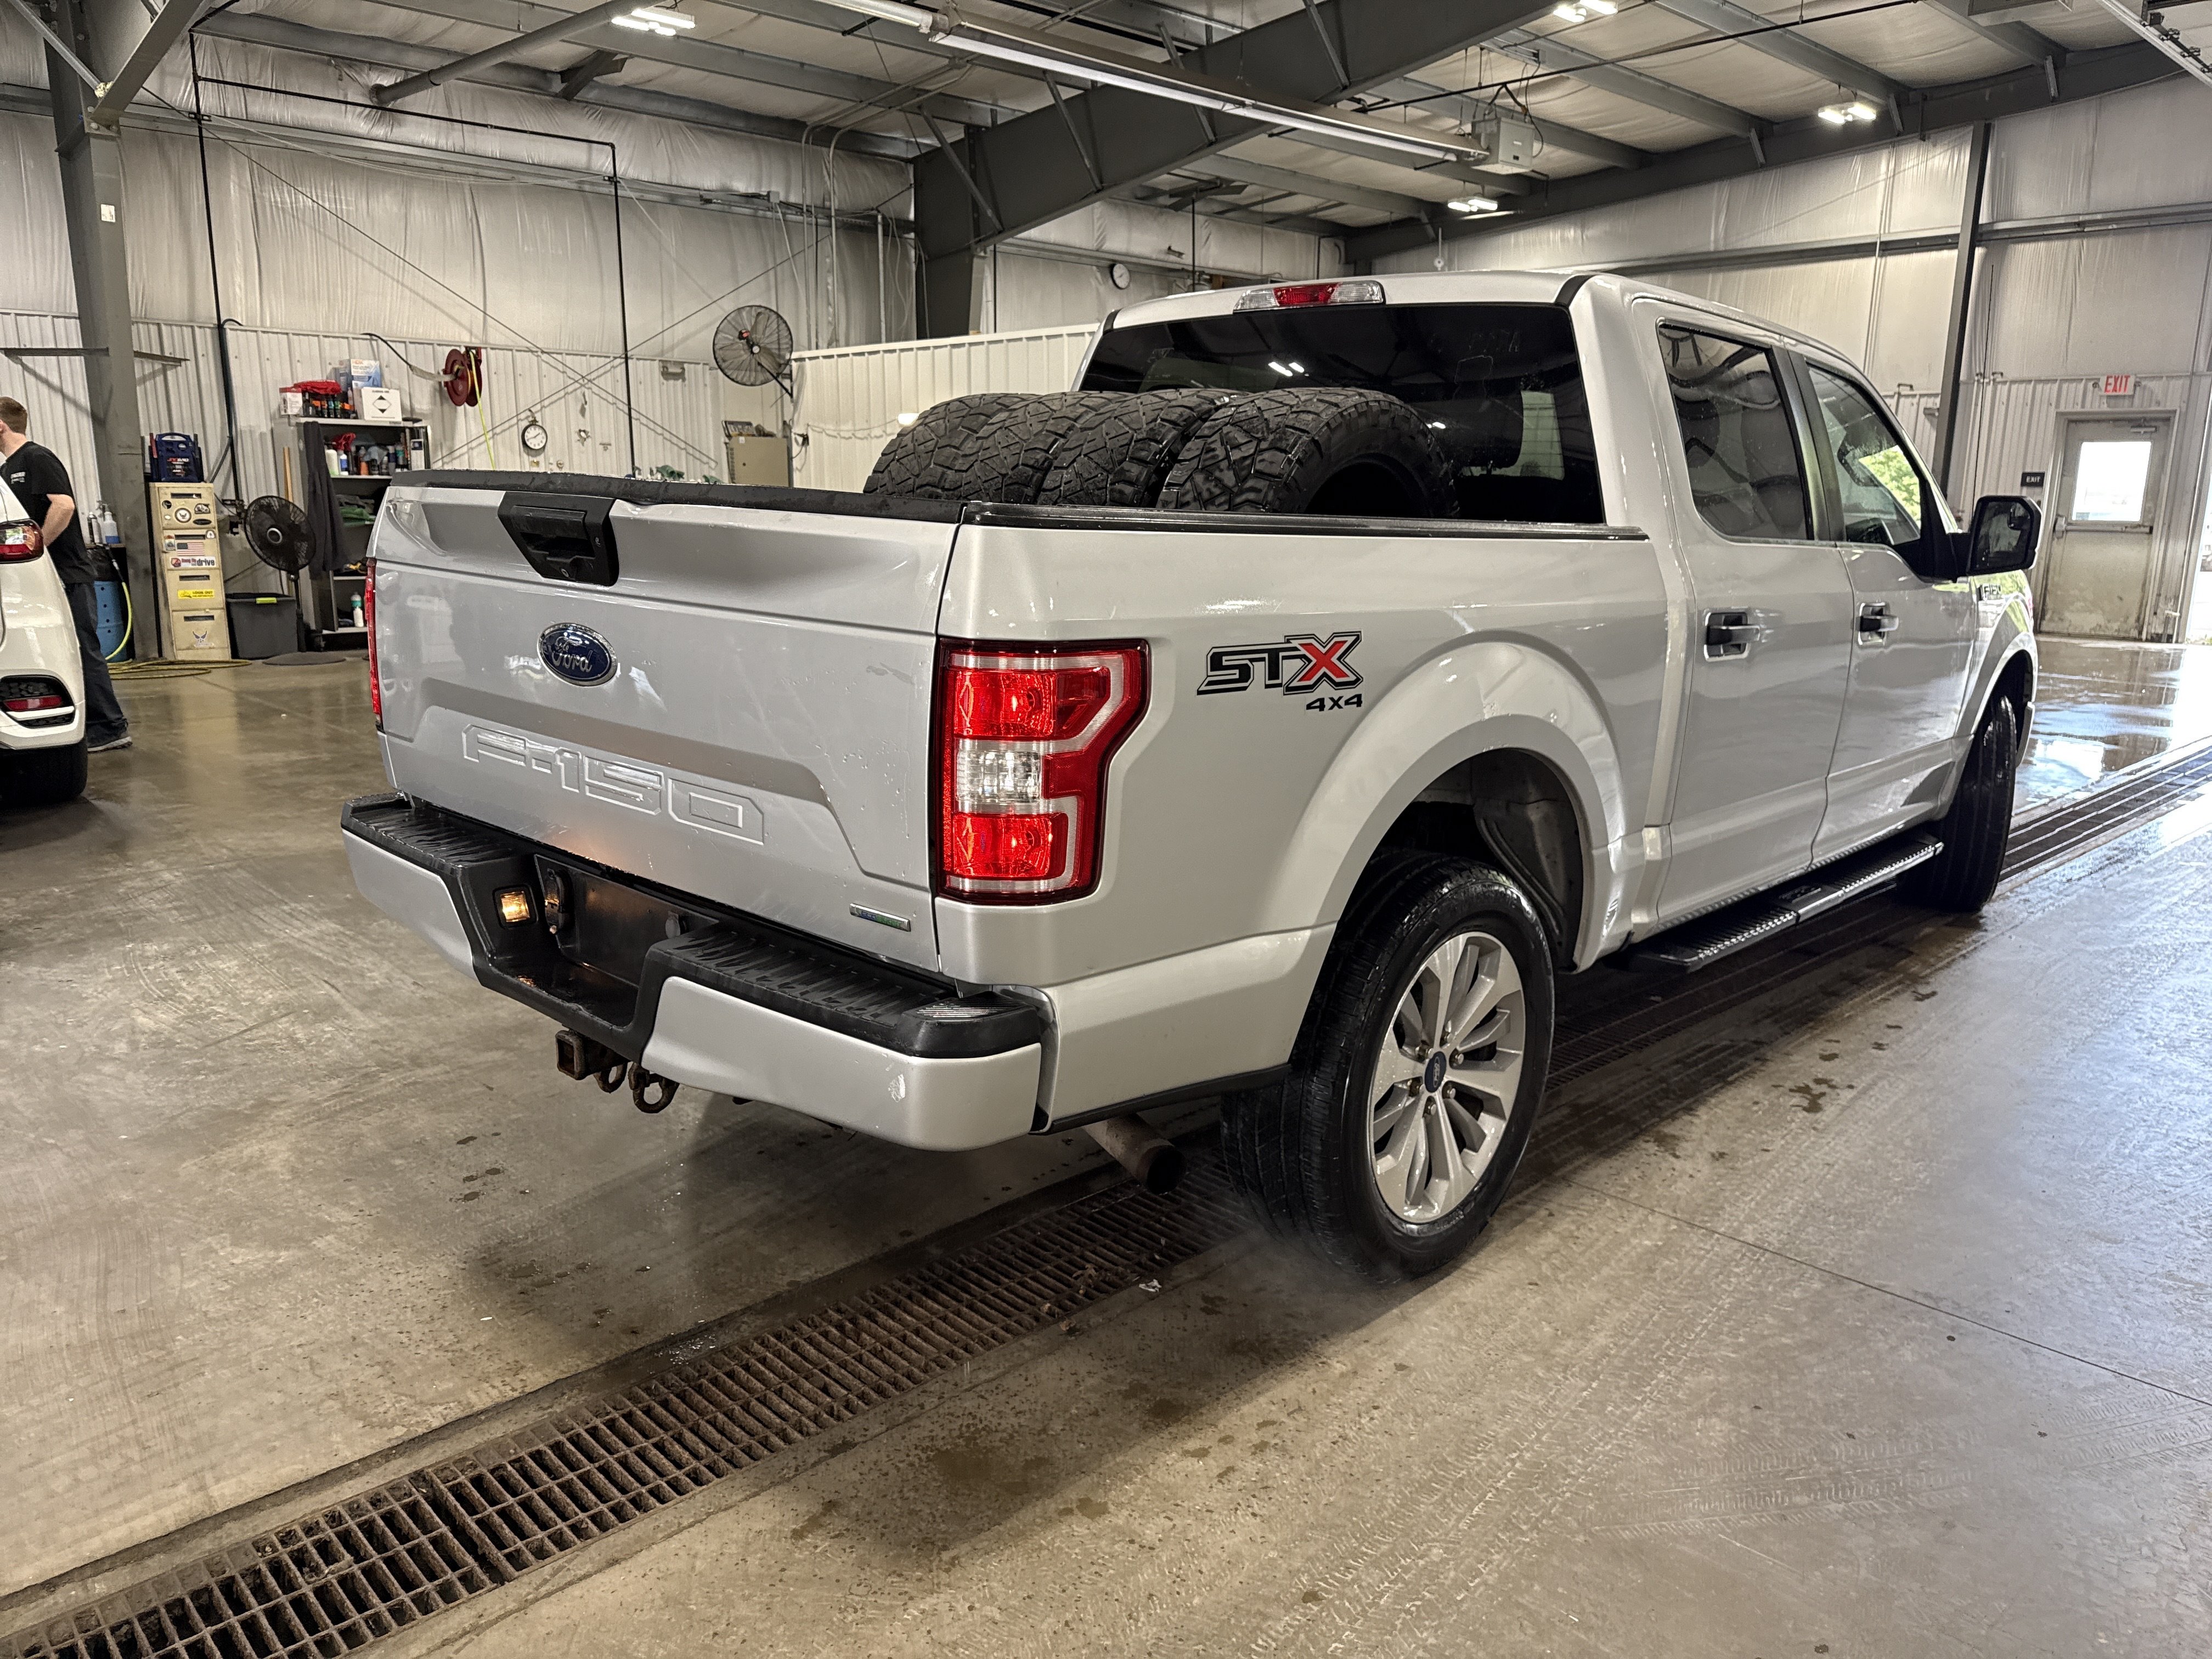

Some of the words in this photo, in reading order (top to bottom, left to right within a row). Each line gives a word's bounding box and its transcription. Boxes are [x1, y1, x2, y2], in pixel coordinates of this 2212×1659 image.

[2104, 375, 2130, 393] EXIT
[551, 636, 592, 672] Ford
[1197, 631, 1363, 696] STX
[462, 724, 764, 845] F-150
